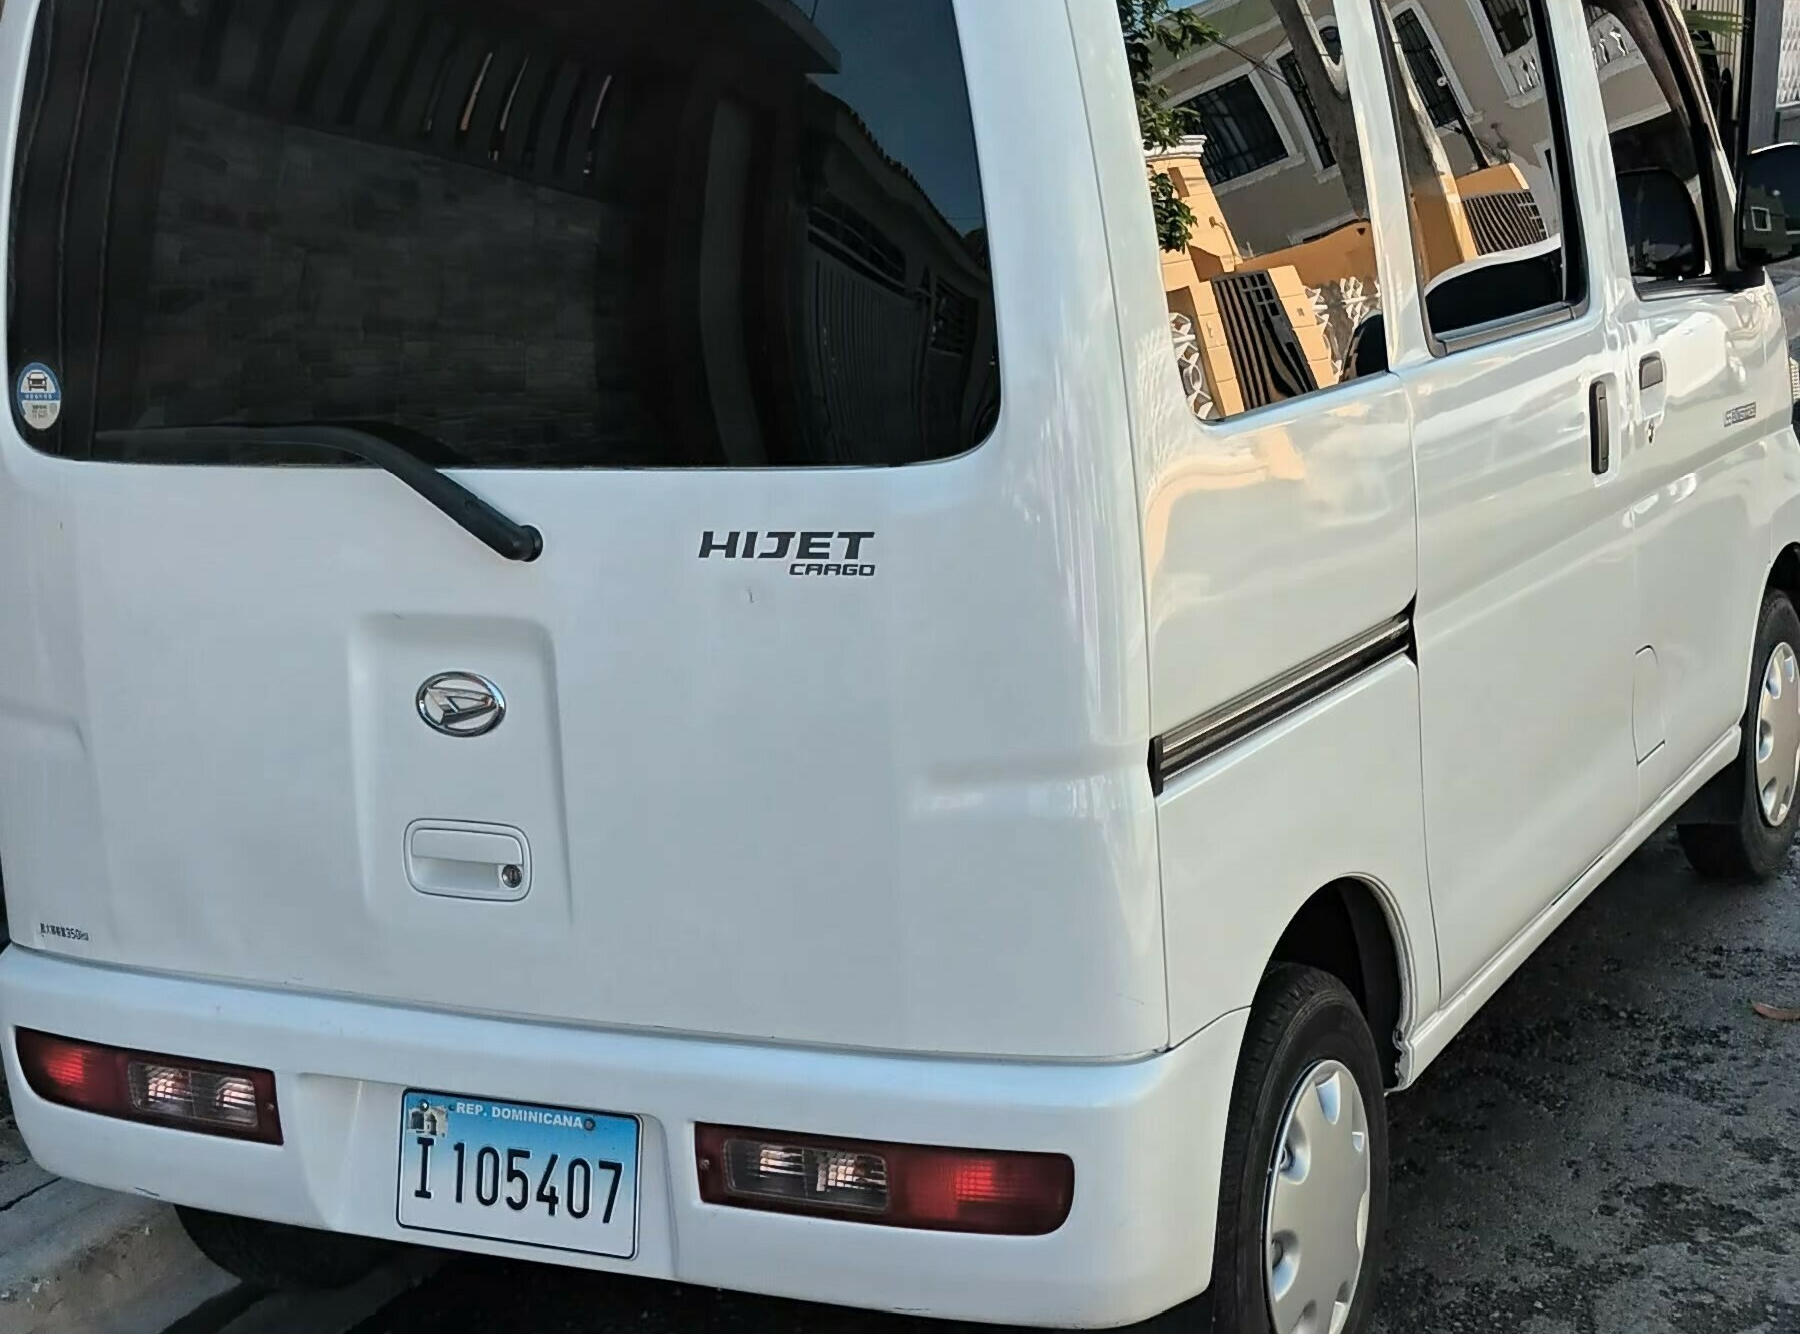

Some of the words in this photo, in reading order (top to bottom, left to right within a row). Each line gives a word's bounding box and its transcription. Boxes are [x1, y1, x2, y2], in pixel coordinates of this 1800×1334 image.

[698, 531, 876, 560] HIJET
[789, 563, 876, 577] CARGO
[456, 1102, 488, 1118] REP.
[491, 1108, 583, 1130] DOMINICANA
